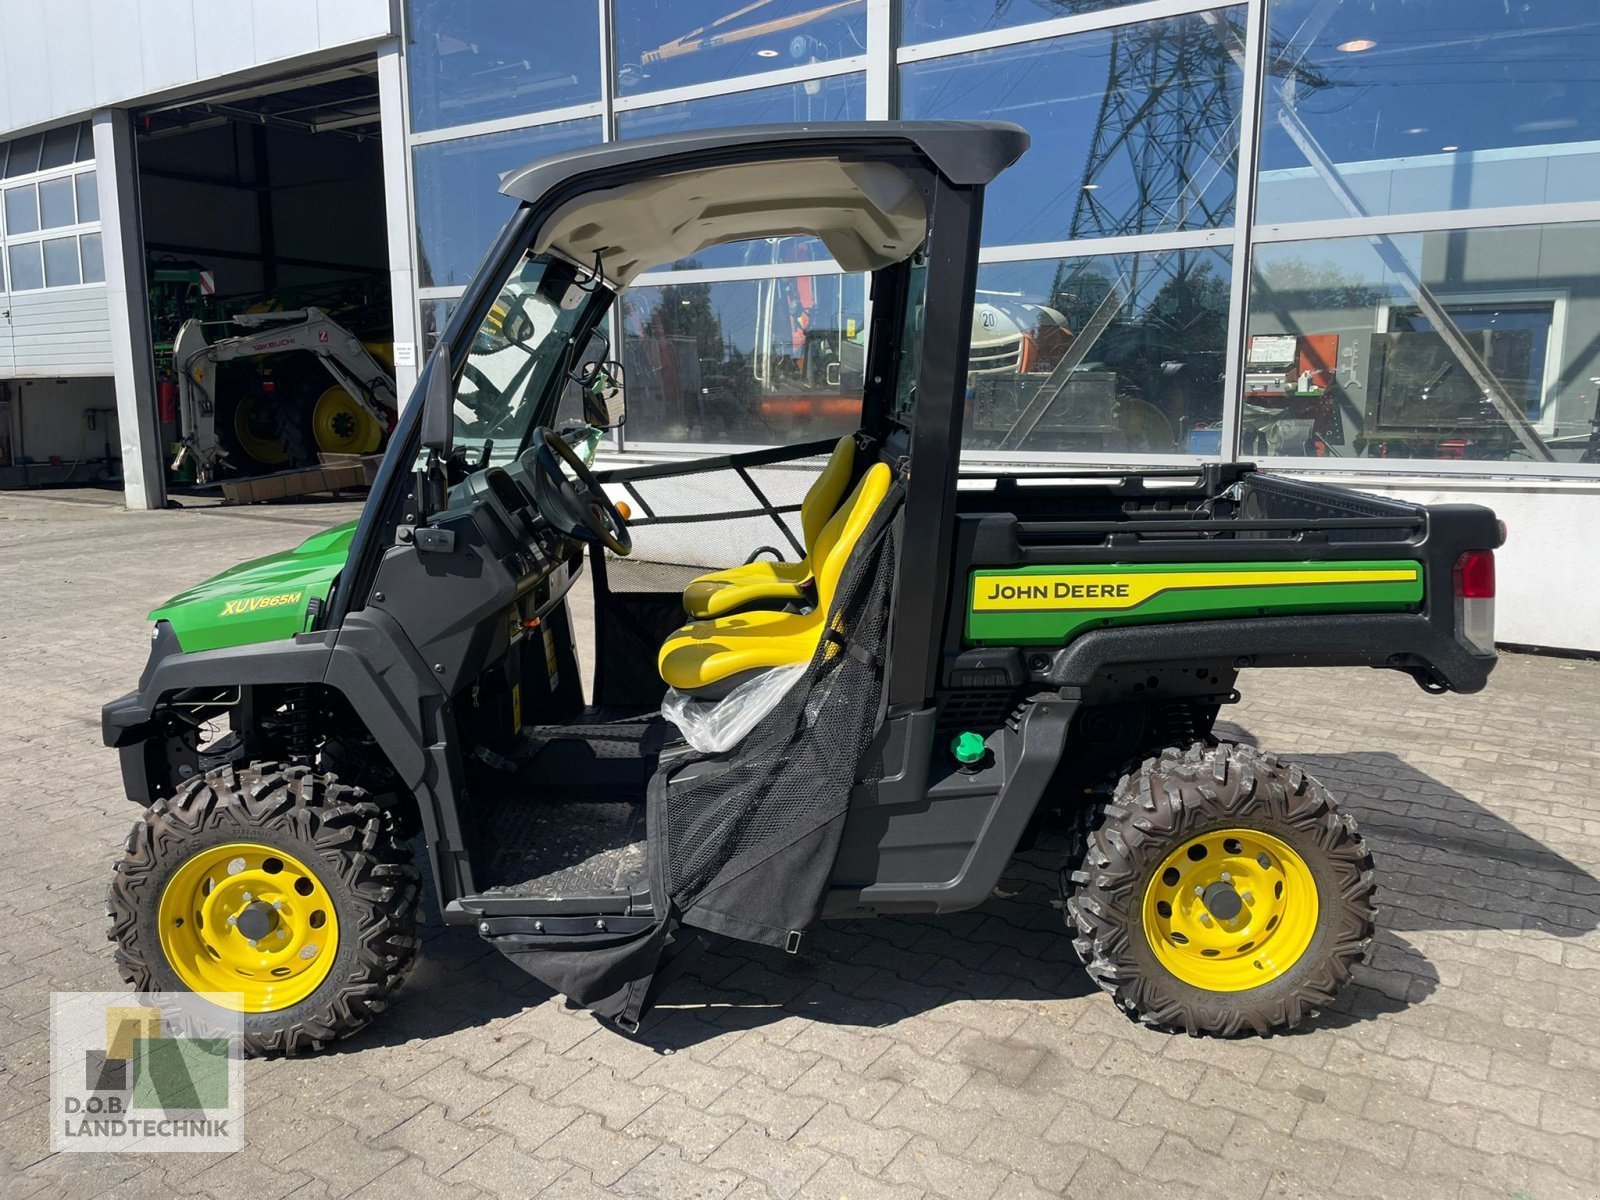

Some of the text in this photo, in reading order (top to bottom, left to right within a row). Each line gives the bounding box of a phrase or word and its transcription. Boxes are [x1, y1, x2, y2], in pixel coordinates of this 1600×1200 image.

[982, 313, 995, 327] 20
[988, 582, 1130, 600] JOHN DEERE
[219, 592, 302, 617] XUV865M
